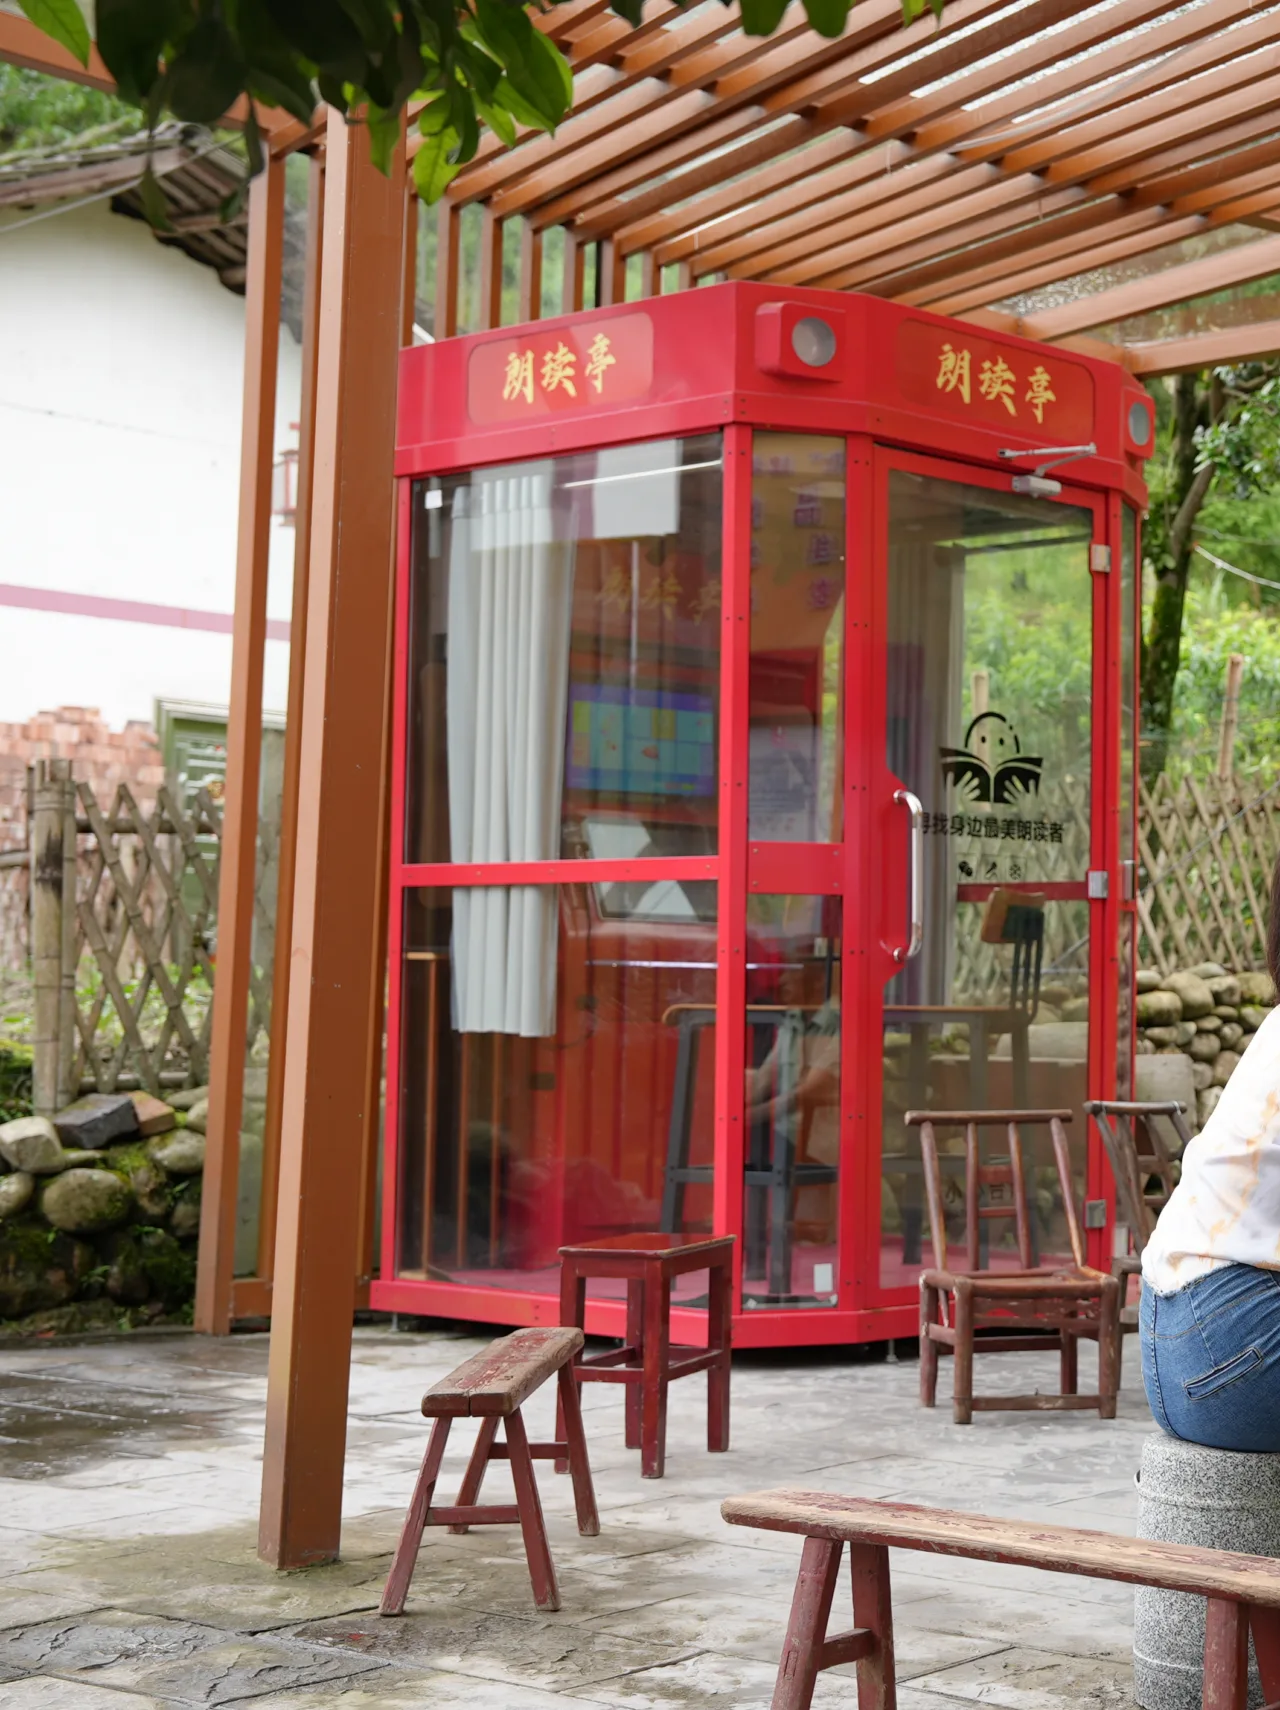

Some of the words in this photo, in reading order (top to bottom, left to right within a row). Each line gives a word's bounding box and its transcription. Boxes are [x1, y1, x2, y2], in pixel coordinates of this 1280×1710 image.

[502, 332, 616, 404] 朗读亭
[936, 343, 1057, 425] 朗读亭
